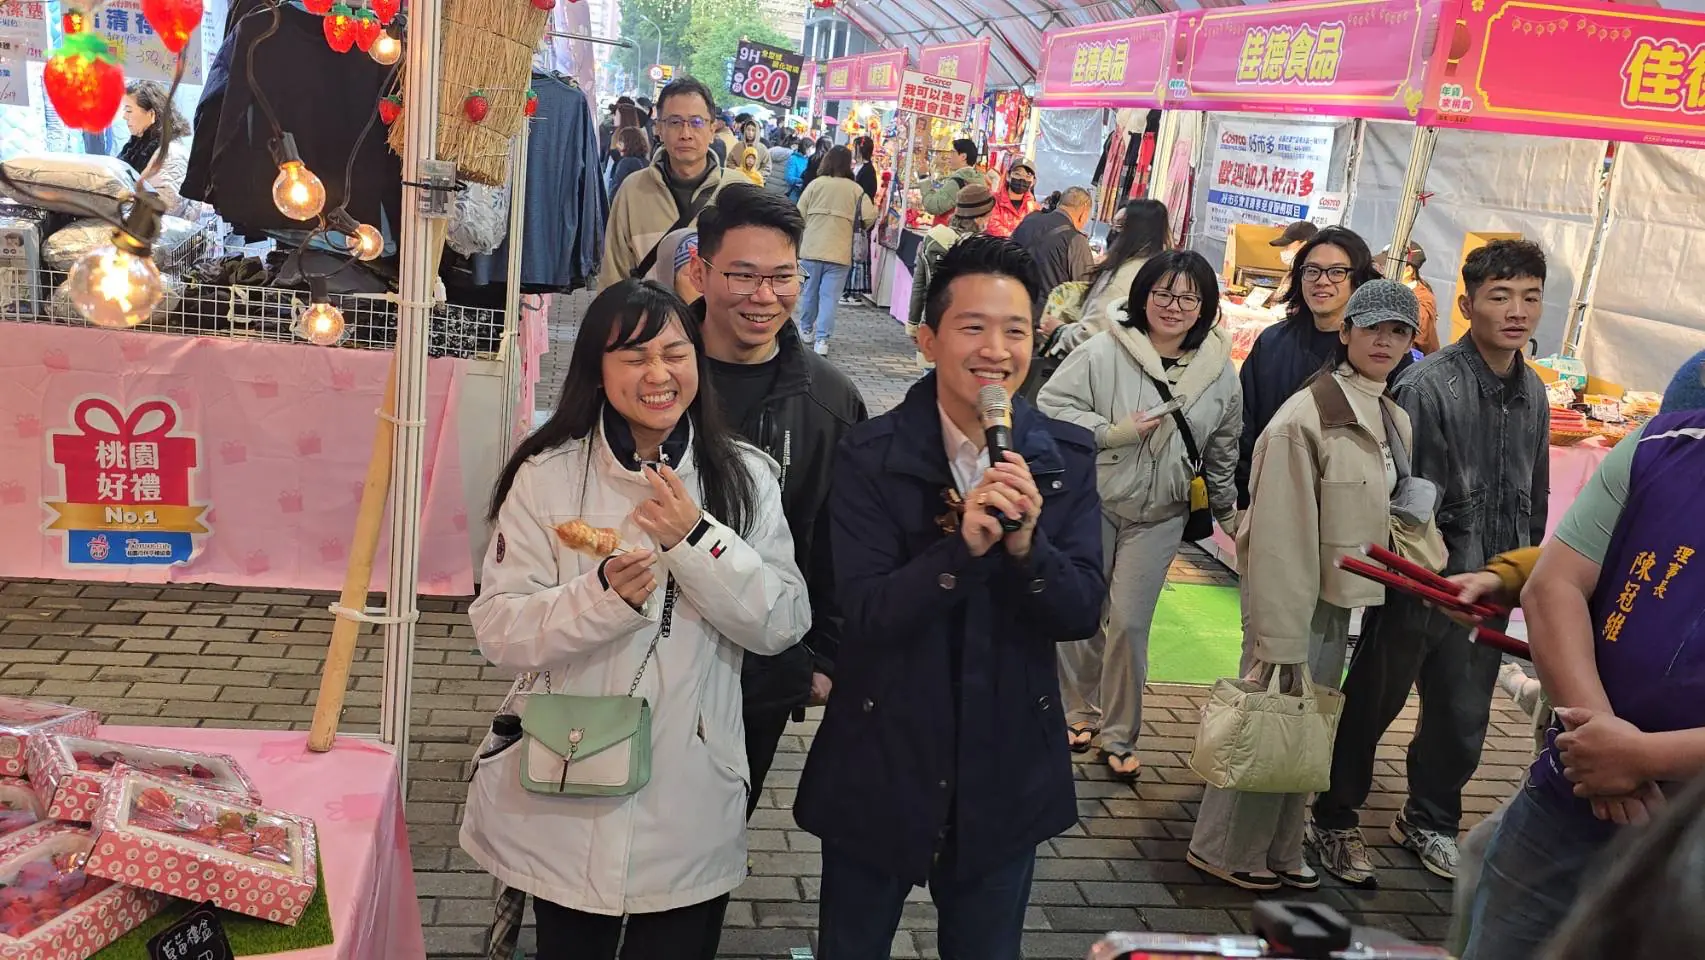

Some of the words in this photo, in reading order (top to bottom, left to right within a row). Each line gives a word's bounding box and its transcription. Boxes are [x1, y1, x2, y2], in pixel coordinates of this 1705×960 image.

[739, 47, 761, 63] 9H
[1071, 41, 1129, 83] 佳德食品
[1239, 26, 1341, 80] 佳德食品
[742, 64, 790, 105] 80
[923, 75, 952, 87] COSTCO
[1627, 43, 1705, 108] 佳
[902, 96, 963, 119] 辦理會員卡
[904, 83, 966, 106] 我可以為您
[1249, 133, 1275, 154] 好市多
[1218, 159, 1315, 197] 歡迎加入好市多
[95, 440, 160, 470] 桃園
[96, 472, 162, 502] 好禮
[105, 507, 158, 526] No.1
[1653, 545, 1695, 599] 理事長
[1602, 552, 1656, 642] 陳冠維
